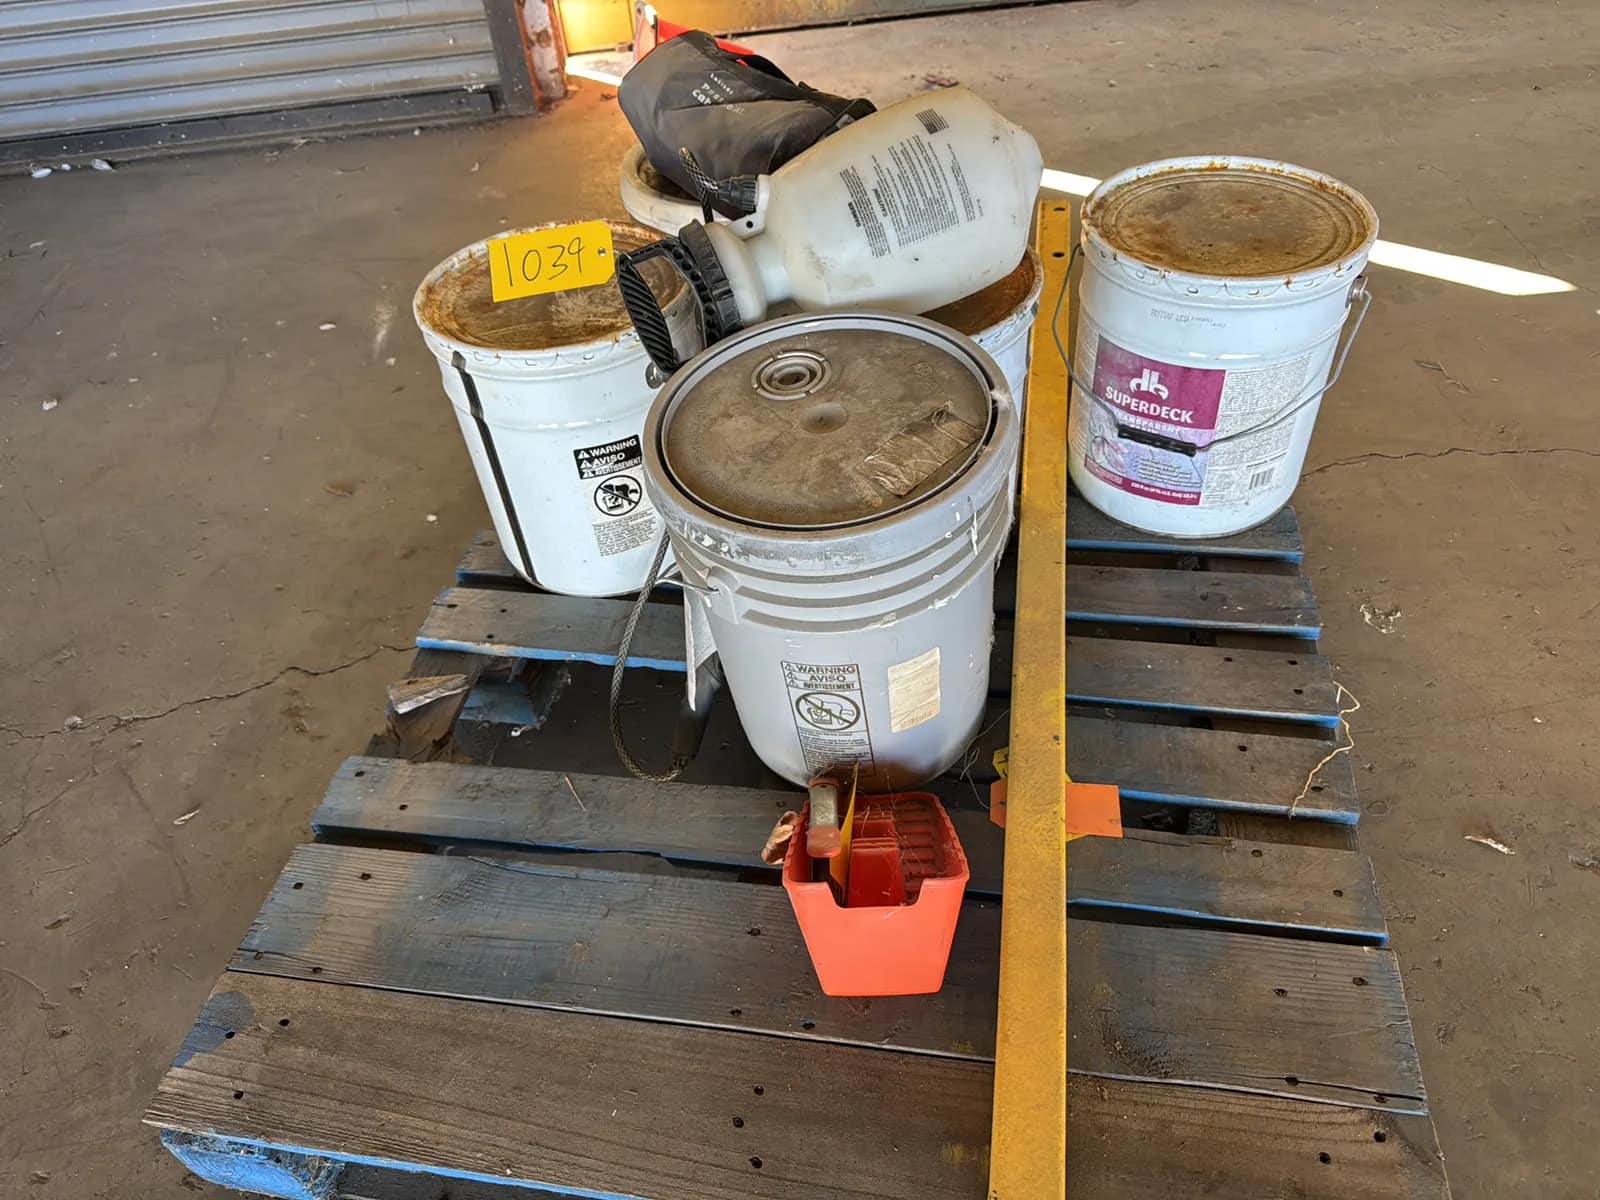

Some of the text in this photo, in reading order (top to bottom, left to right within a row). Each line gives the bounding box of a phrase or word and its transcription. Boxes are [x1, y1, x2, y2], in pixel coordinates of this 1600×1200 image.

[503, 236, 585, 288] 1039
[1105, 385, 1195, 425] SUPERDECK
[589, 438, 638, 457] WARNING
[592, 452, 626, 468] AVISO
[797, 664, 856, 674] WARNING
[803, 682, 855, 690] AVERTISSEMENT
[809, 674, 846, 683] AVISO
